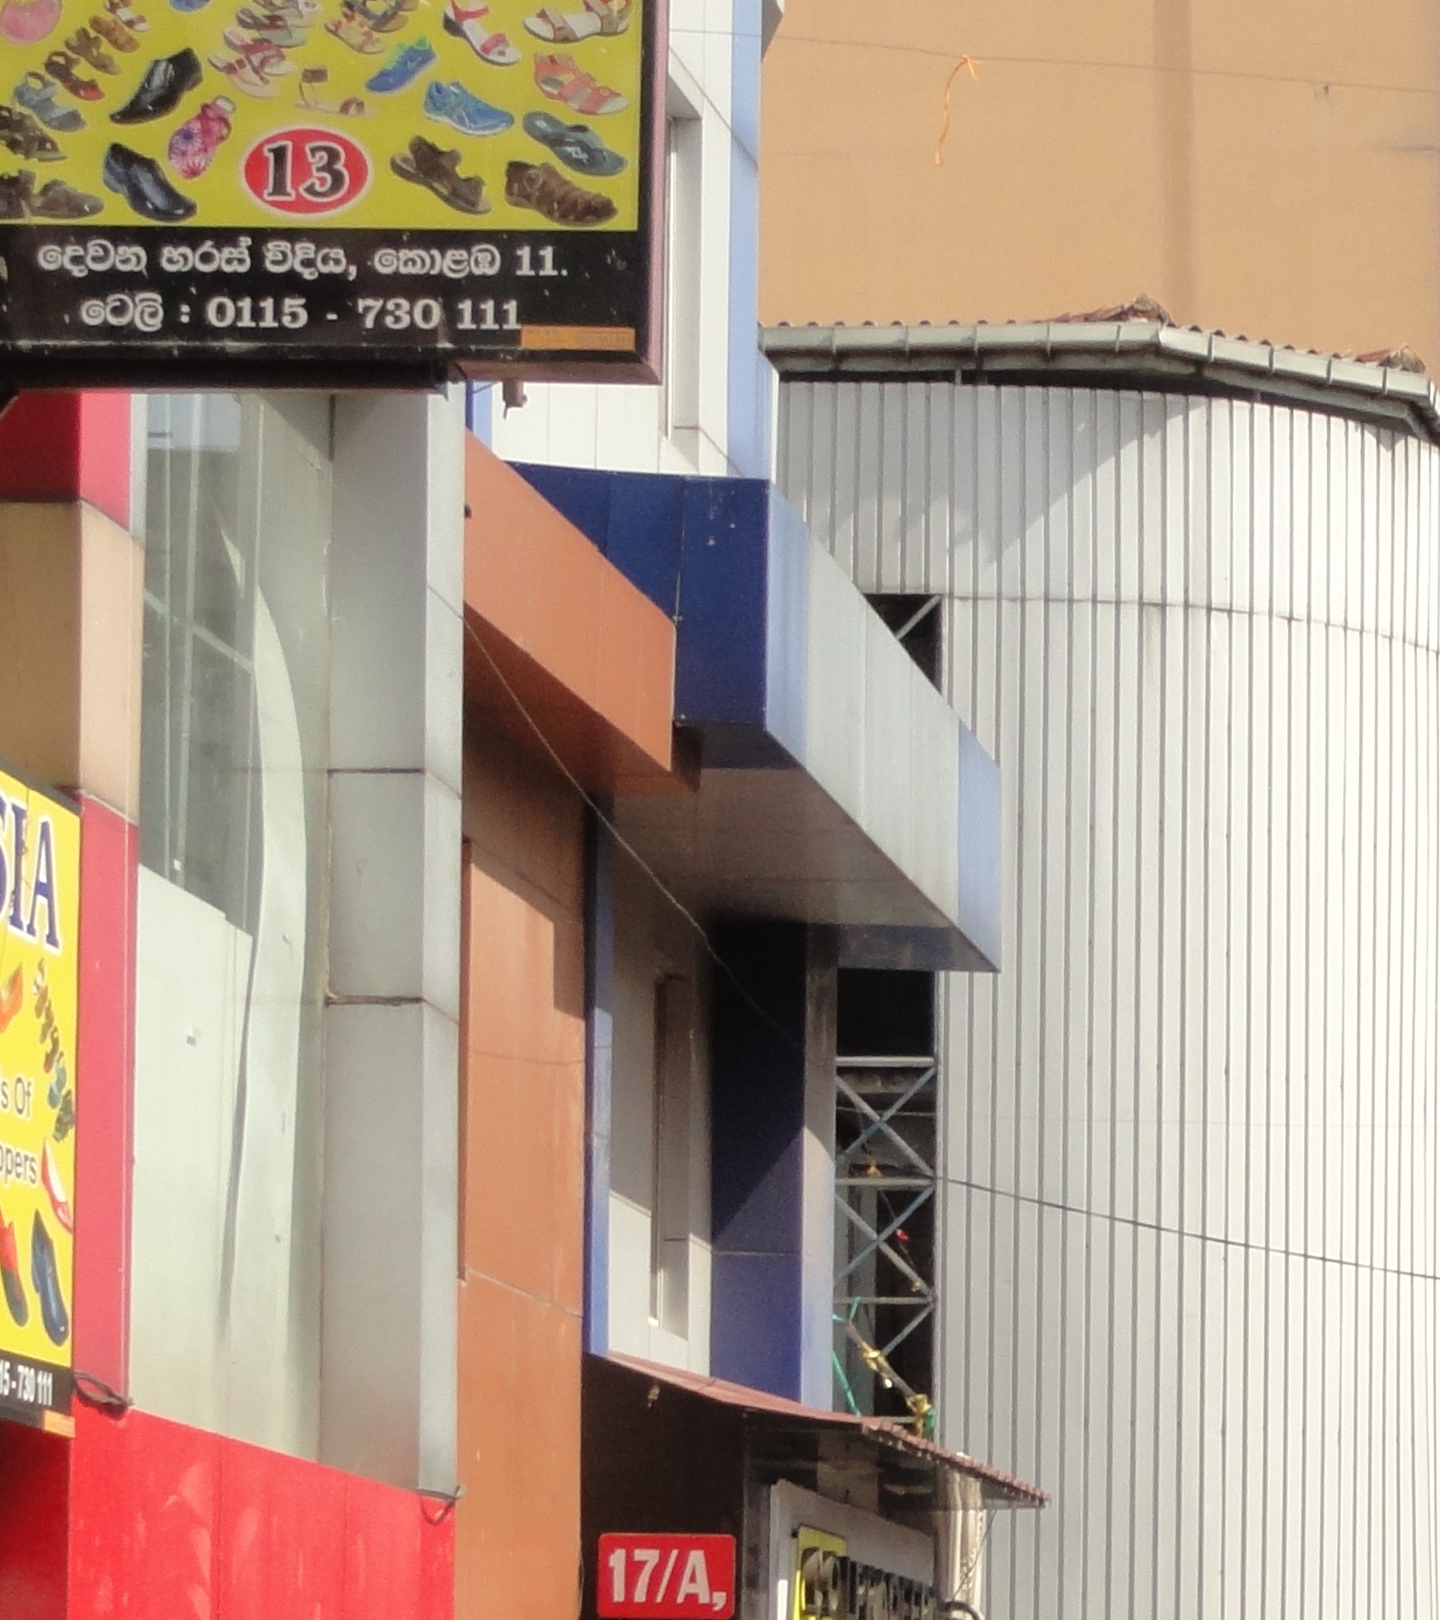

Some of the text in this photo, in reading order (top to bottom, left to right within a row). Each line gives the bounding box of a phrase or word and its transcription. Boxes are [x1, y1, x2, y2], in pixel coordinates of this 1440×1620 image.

[265, 142, 348, 200] 13
[37, 240, 148, 275] දෙවන
[161, 238, 251, 273] හරස්
[374, 243, 502, 276] කොළඹ
[515, 245, 569, 277] 11.
[80, 292, 522, 331] ටෙලි : 0115 - 730 111
[608, 1548, 728, 1612] 17/A,
